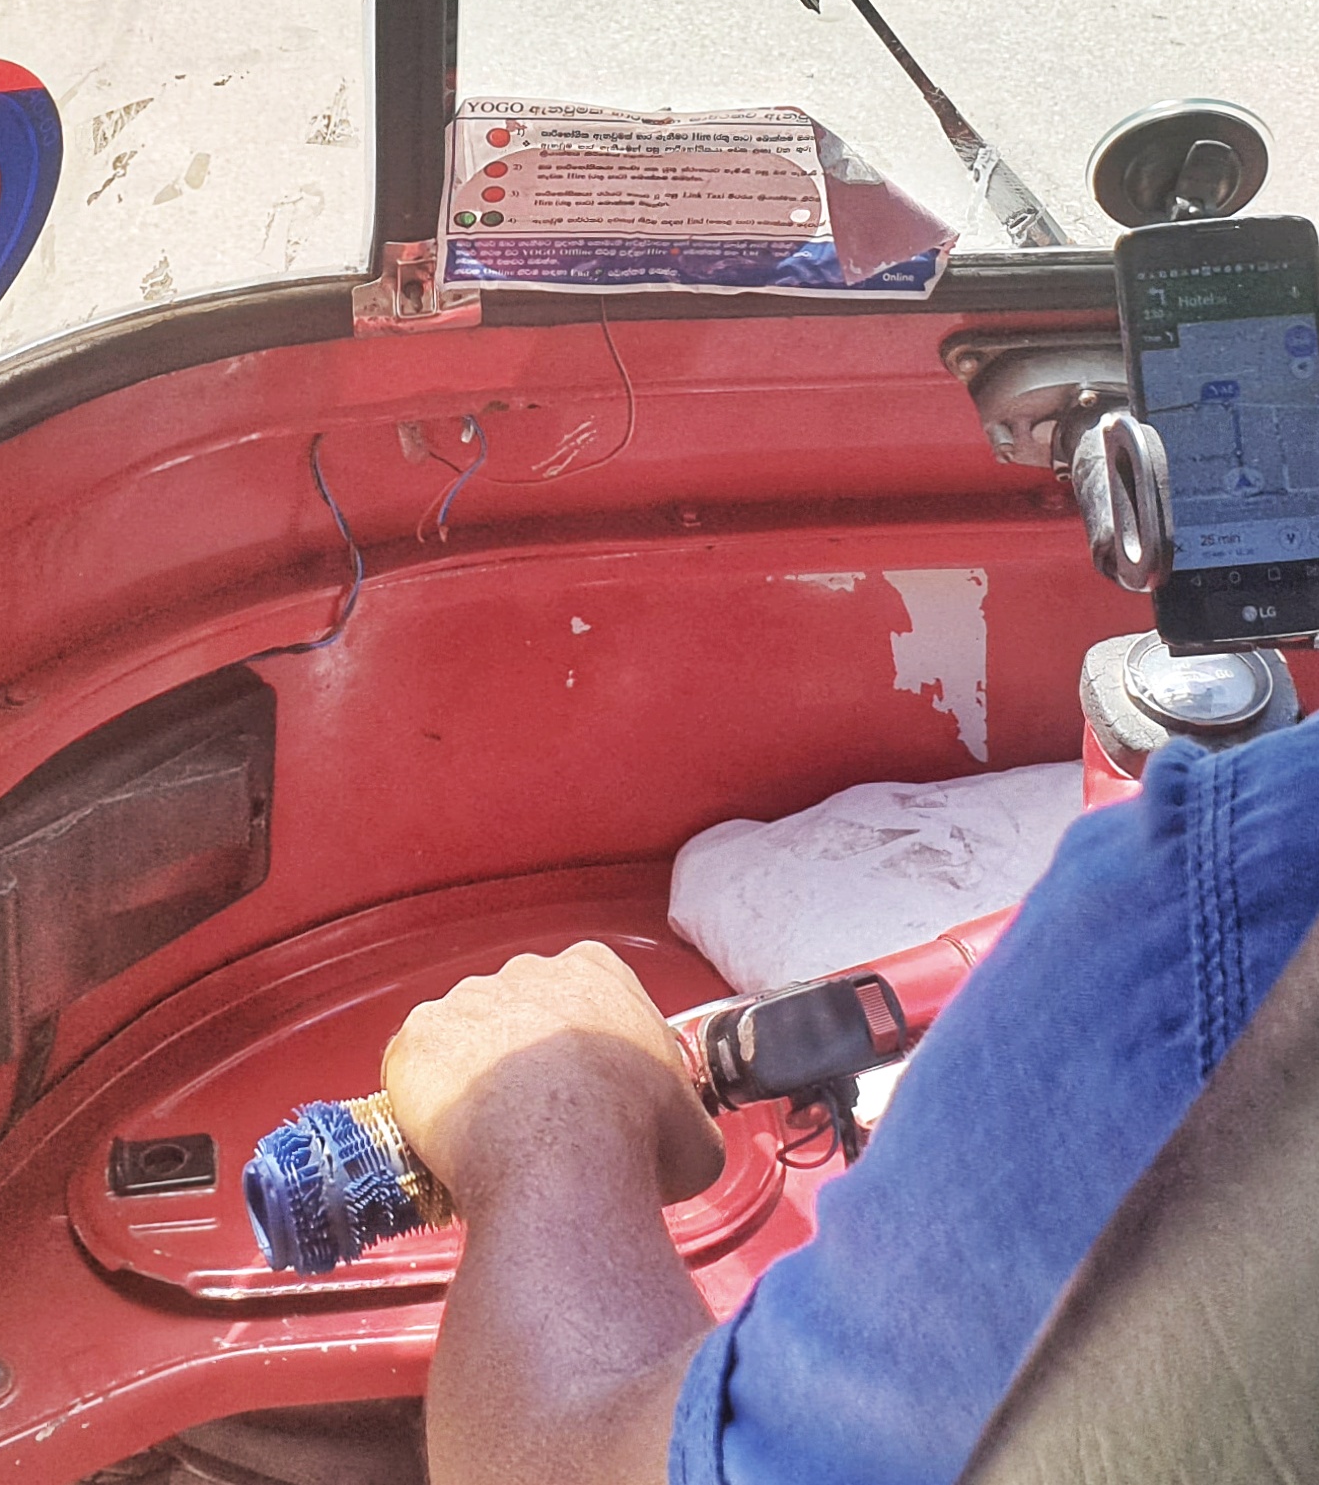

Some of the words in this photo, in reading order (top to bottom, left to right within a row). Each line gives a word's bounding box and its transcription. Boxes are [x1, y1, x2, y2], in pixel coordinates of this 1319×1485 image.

[467, 102, 524, 113] YOGO
[692, 133, 711, 142] Hire
[683, 191, 701, 199] Link
[687, 217, 703, 225] End
[483, 268, 514, 276] Online
[882, 272, 915, 283] Online
[1218, 533, 1241, 545] min
[1259, 606, 1277, 619] LG
